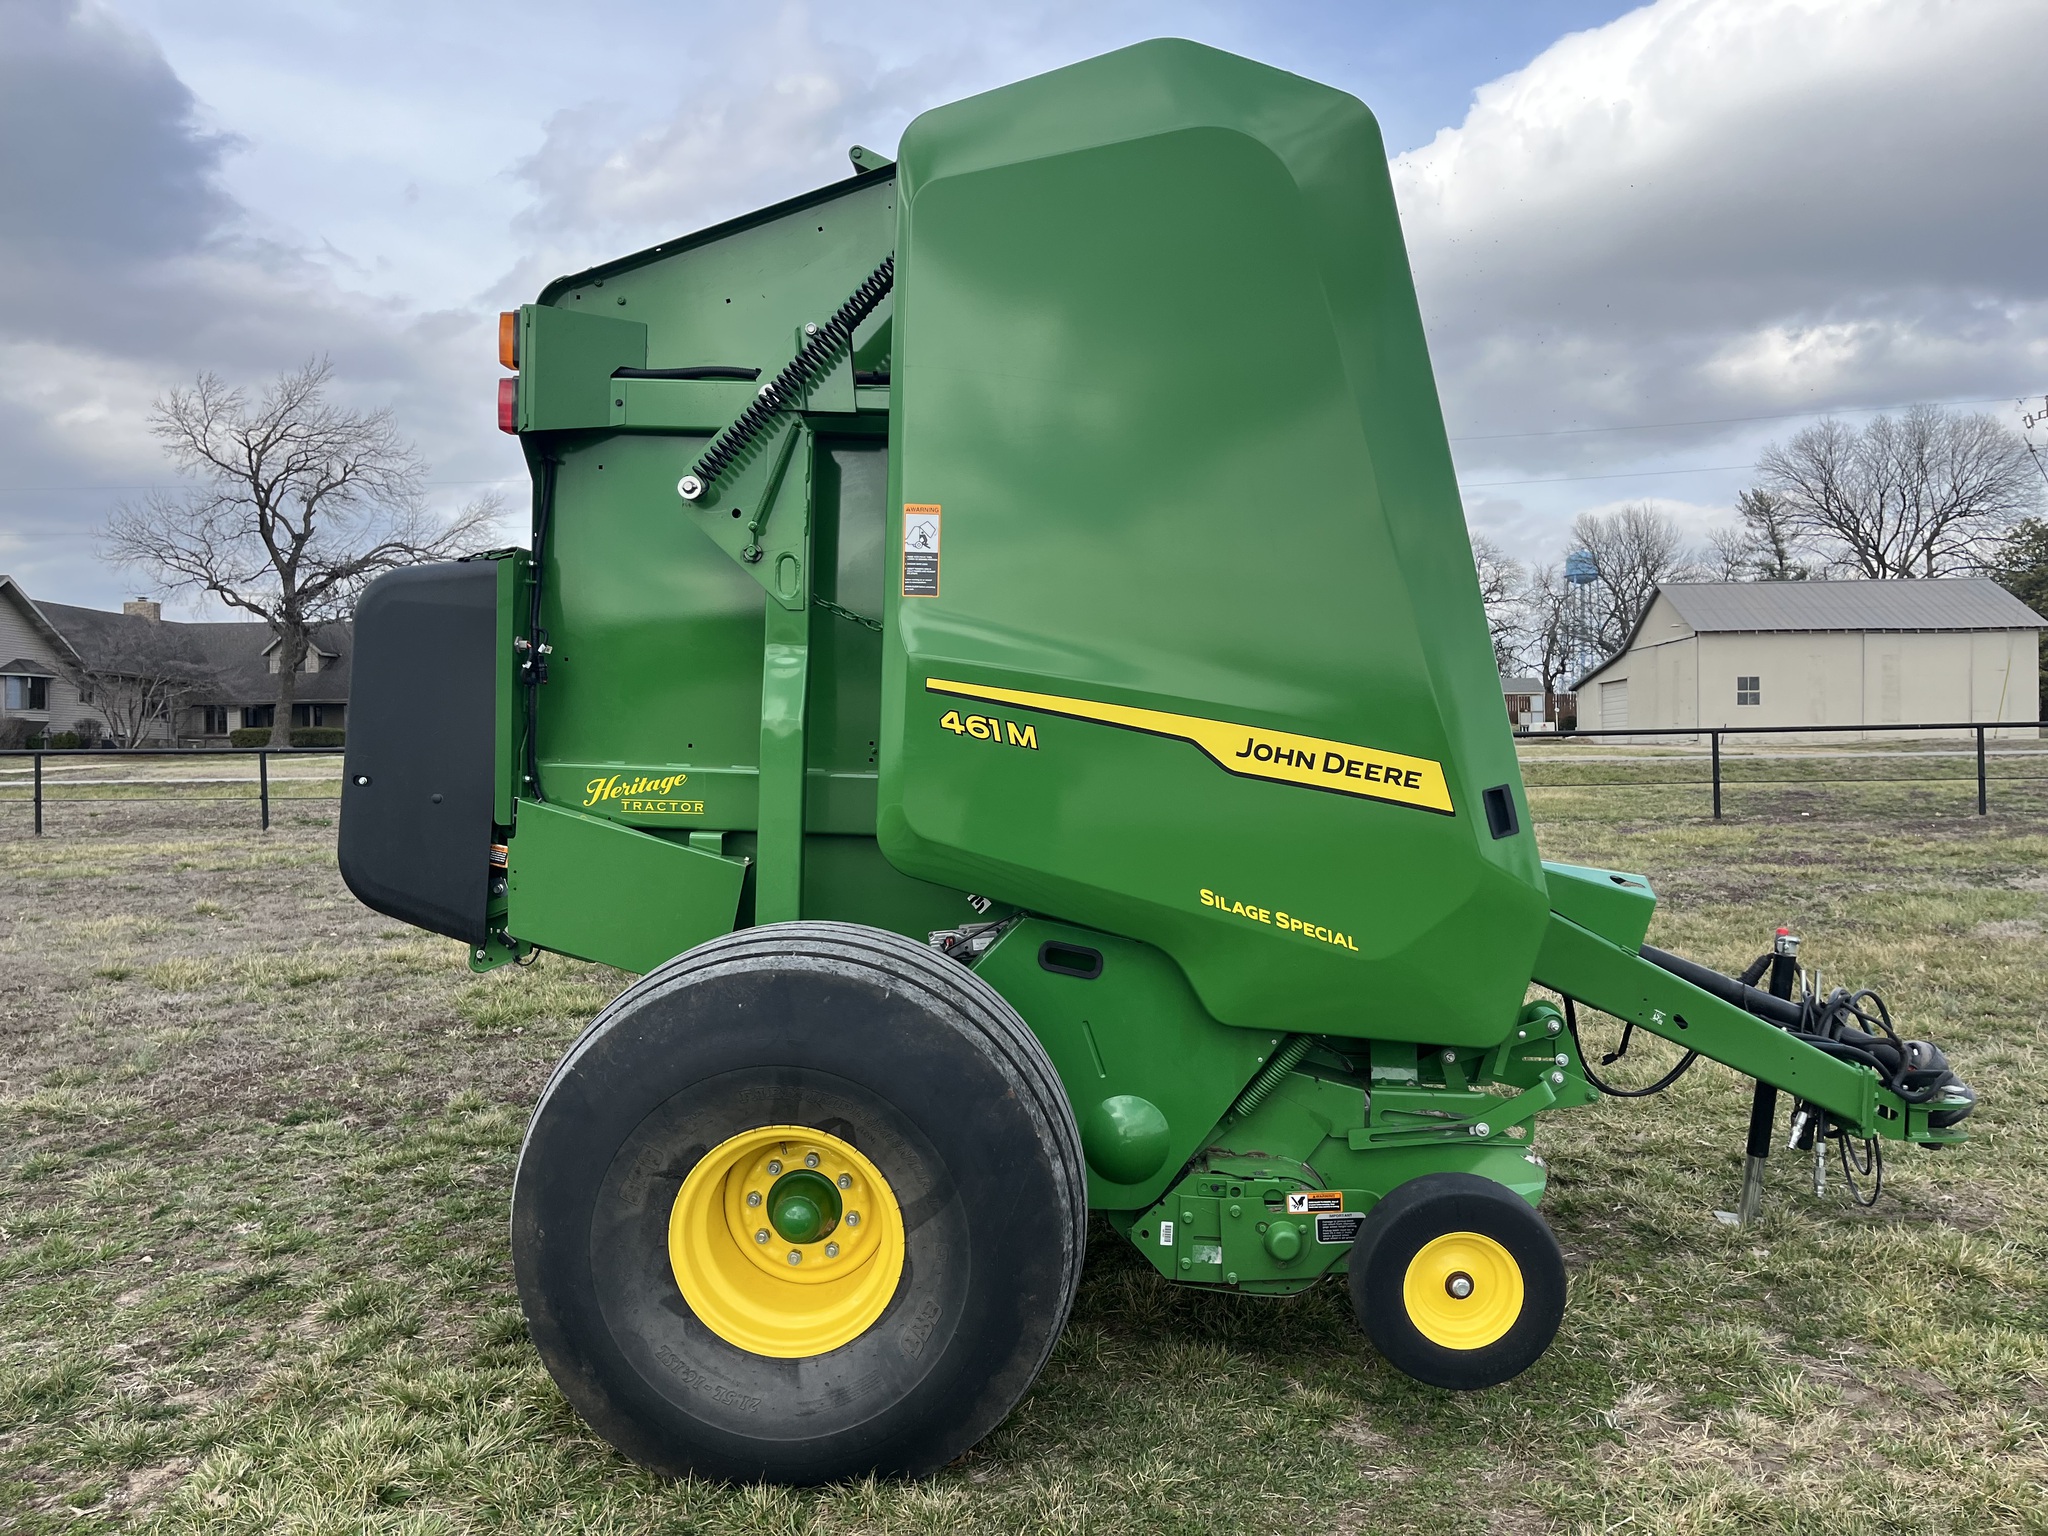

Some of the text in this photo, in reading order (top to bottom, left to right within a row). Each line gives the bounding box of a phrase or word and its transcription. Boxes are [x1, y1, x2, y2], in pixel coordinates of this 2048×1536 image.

[939, 709, 1039, 751] 461 M
[1235, 737, 1422, 791] JOHN DEERE
[582, 773, 688, 807] Heritage
[621, 801, 704, 813] TRACTOR
[1199, 887, 1359, 952] SILAGE SPECIAL
